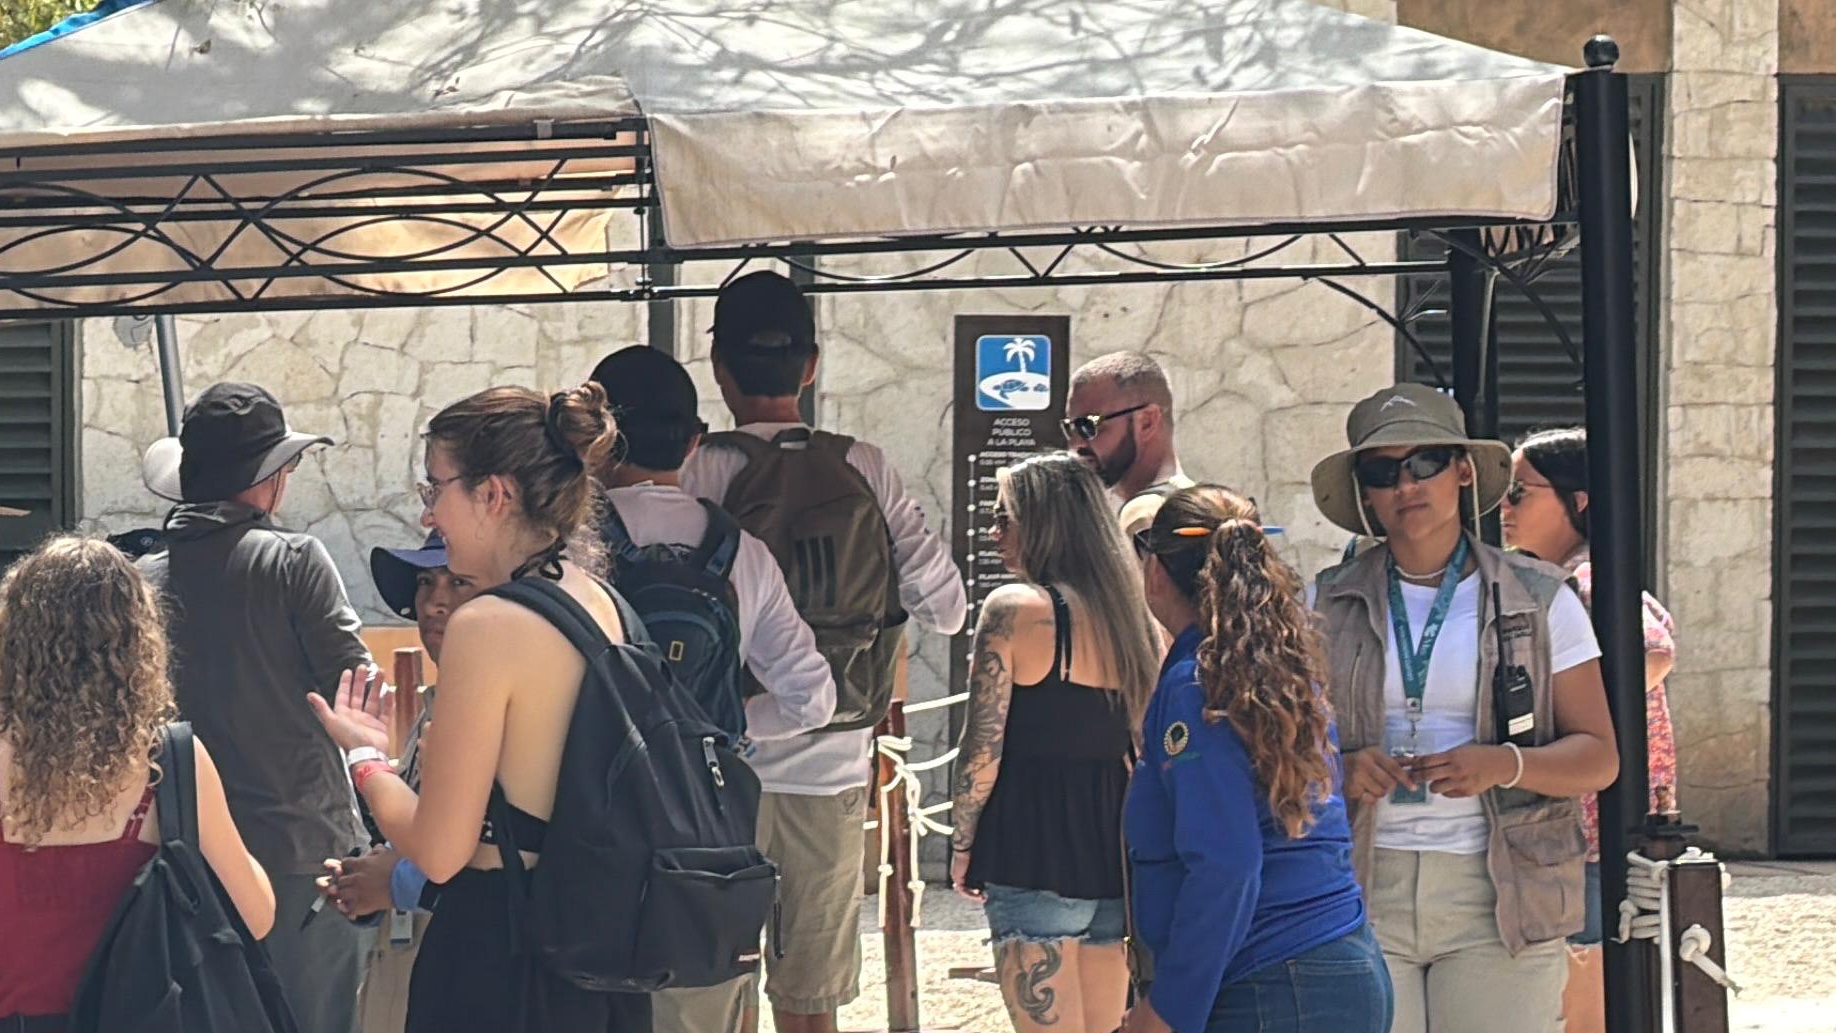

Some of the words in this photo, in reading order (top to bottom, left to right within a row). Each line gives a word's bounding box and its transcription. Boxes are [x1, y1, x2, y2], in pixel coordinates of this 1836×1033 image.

[993, 418, 1031, 427] ACCESO
[986, 438, 994, 446] A
[995, 438, 1008, 446] LA
[1008, 438, 1037, 446] PLAYA
